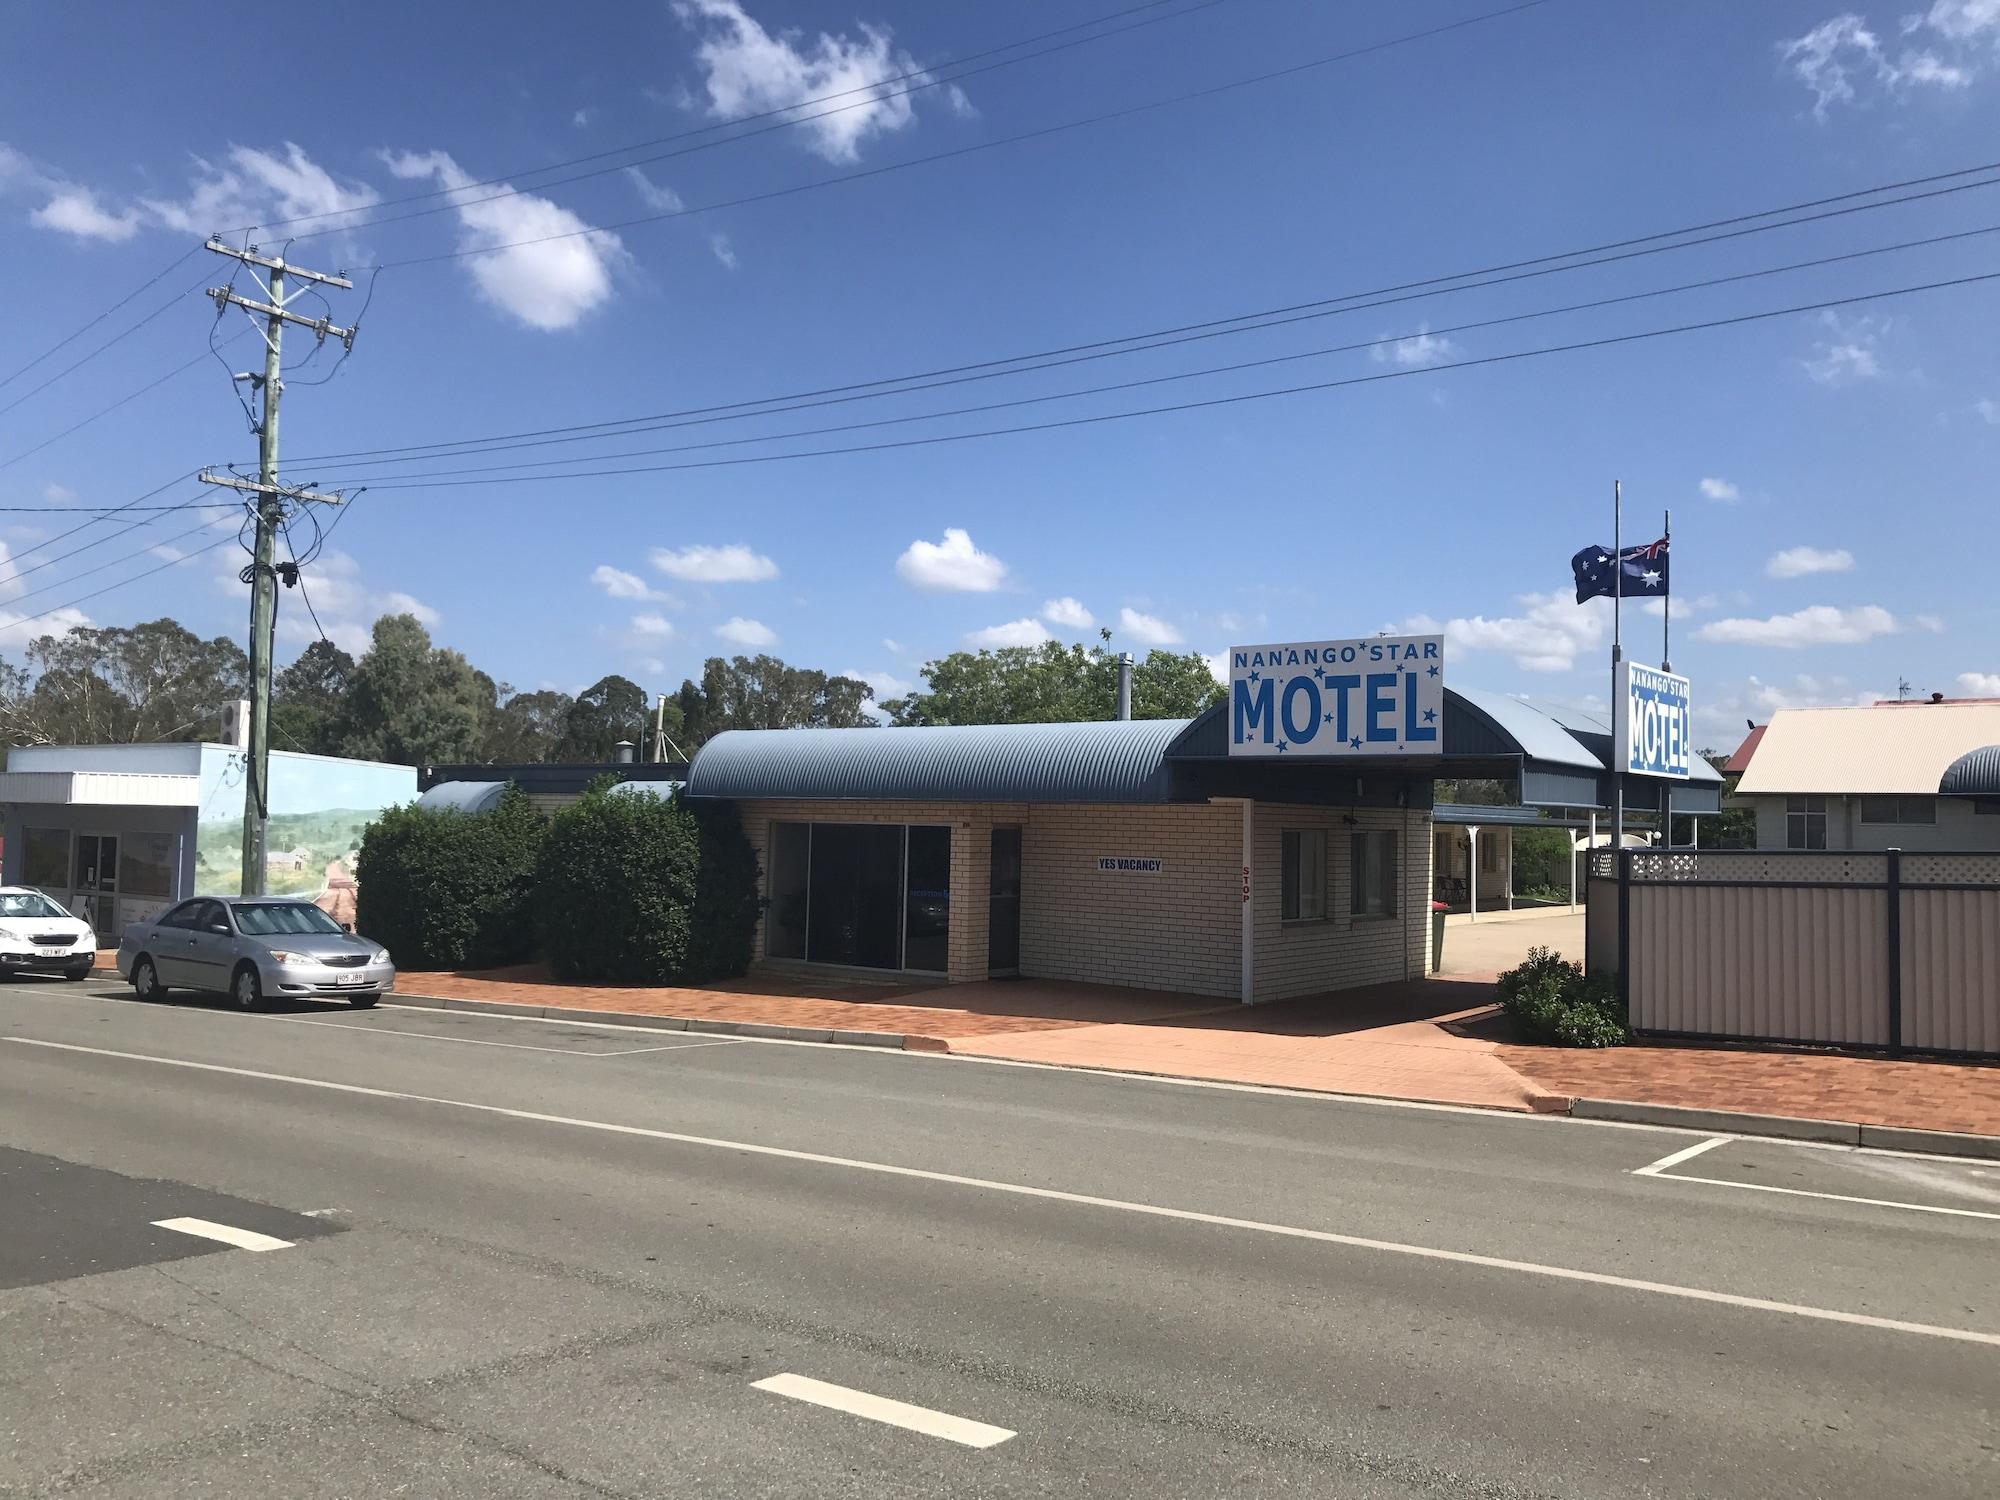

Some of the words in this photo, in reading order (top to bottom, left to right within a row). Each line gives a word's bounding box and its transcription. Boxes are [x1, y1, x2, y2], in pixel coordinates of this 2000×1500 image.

[1234, 646, 1356, 668] NANANGO
[1369, 642, 1439, 661] STAR
[1631, 670, 1668, 693] NANANGO
[1670, 682, 1688, 697] STAR
[1233, 672, 1437, 744] MOTEL
[1630, 696, 1688, 768] MOTEL
[1099, 858, 1116, 870] YES
[1117, 859, 1161, 872] VACANCY
[1242, 866, 1250, 903] STOP
